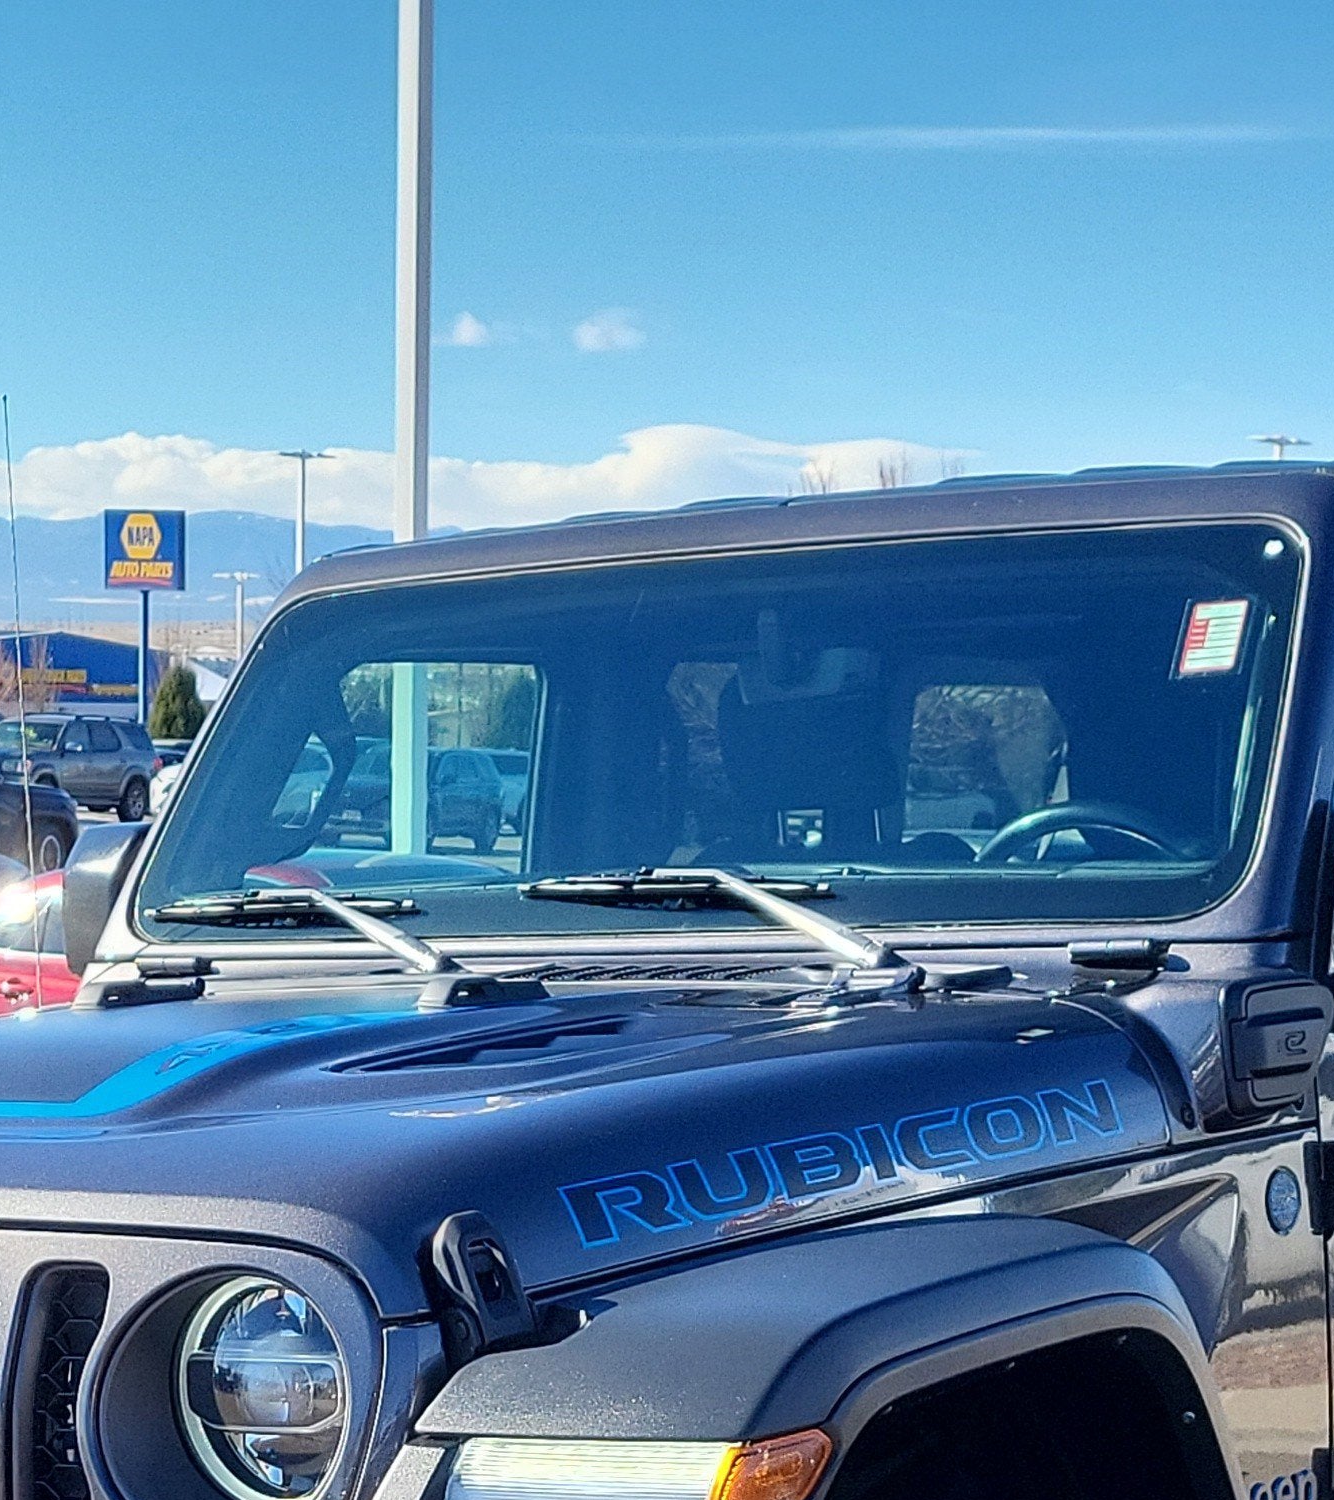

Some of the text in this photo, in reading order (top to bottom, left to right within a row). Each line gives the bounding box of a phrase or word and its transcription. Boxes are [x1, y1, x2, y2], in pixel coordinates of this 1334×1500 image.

[128, 526, 155, 547] NAPA
[110, 561, 173, 578] AUTO PARTS
[557, 1079, 1123, 1249] RUBICON
